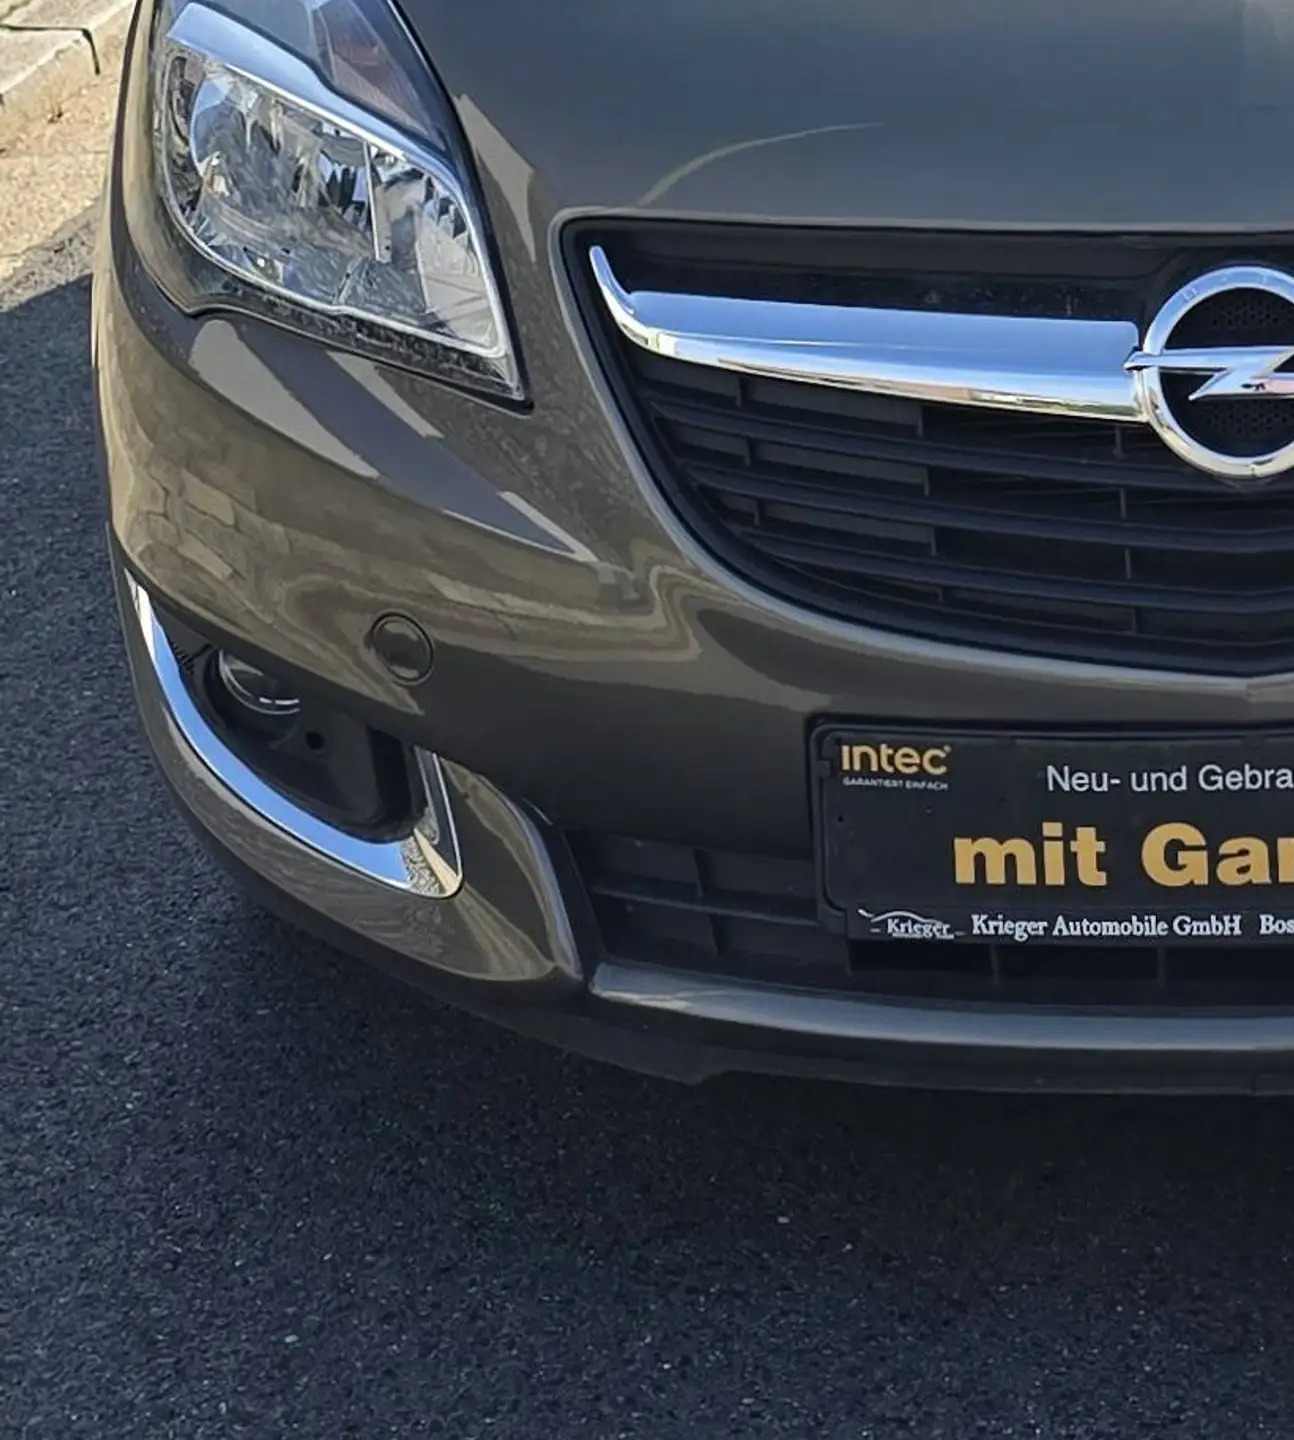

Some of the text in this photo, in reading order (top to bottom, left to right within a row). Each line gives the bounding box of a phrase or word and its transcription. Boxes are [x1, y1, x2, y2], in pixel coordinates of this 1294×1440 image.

[842, 776, 949, 791] GARANTIERT EINFACH
[1046, 764, 1121, 792] Neu-
[1131, 764, 1187, 792] und
[953, 822, 1107, 886] mit
[971, 914, 1048, 942] Krieger
[1052, 915, 1169, 936] Automobile
[1172, 914, 1242, 936] GmbH
